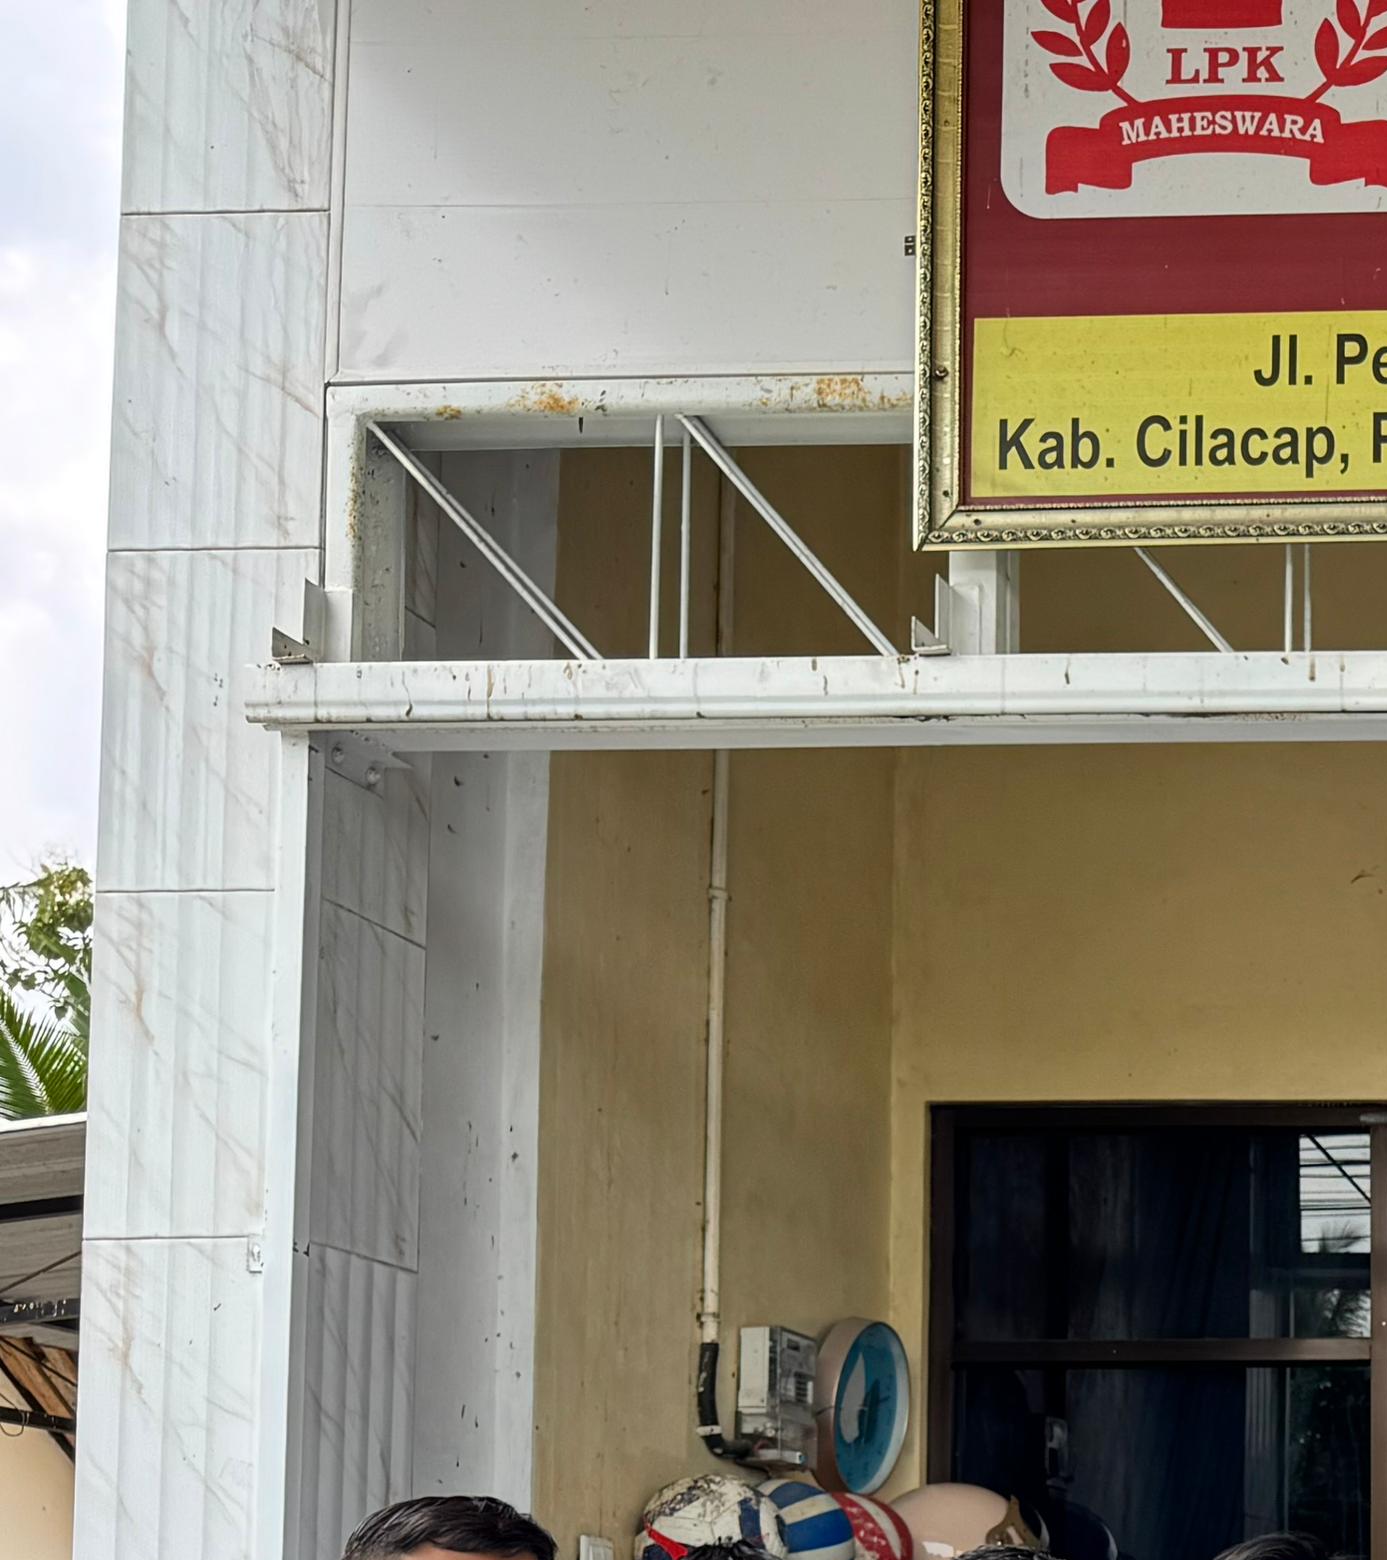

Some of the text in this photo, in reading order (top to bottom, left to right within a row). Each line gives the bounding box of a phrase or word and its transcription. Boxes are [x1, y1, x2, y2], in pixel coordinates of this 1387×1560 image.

[1165, 46, 1285, 85] LPK
[1119, 110, 1325, 146] MAHESWARA
[1254, 335, 1312, 386] Jl.
[998, 417, 1115, 470] Kab.
[1137, 415, 1348, 478] Cilacap,
